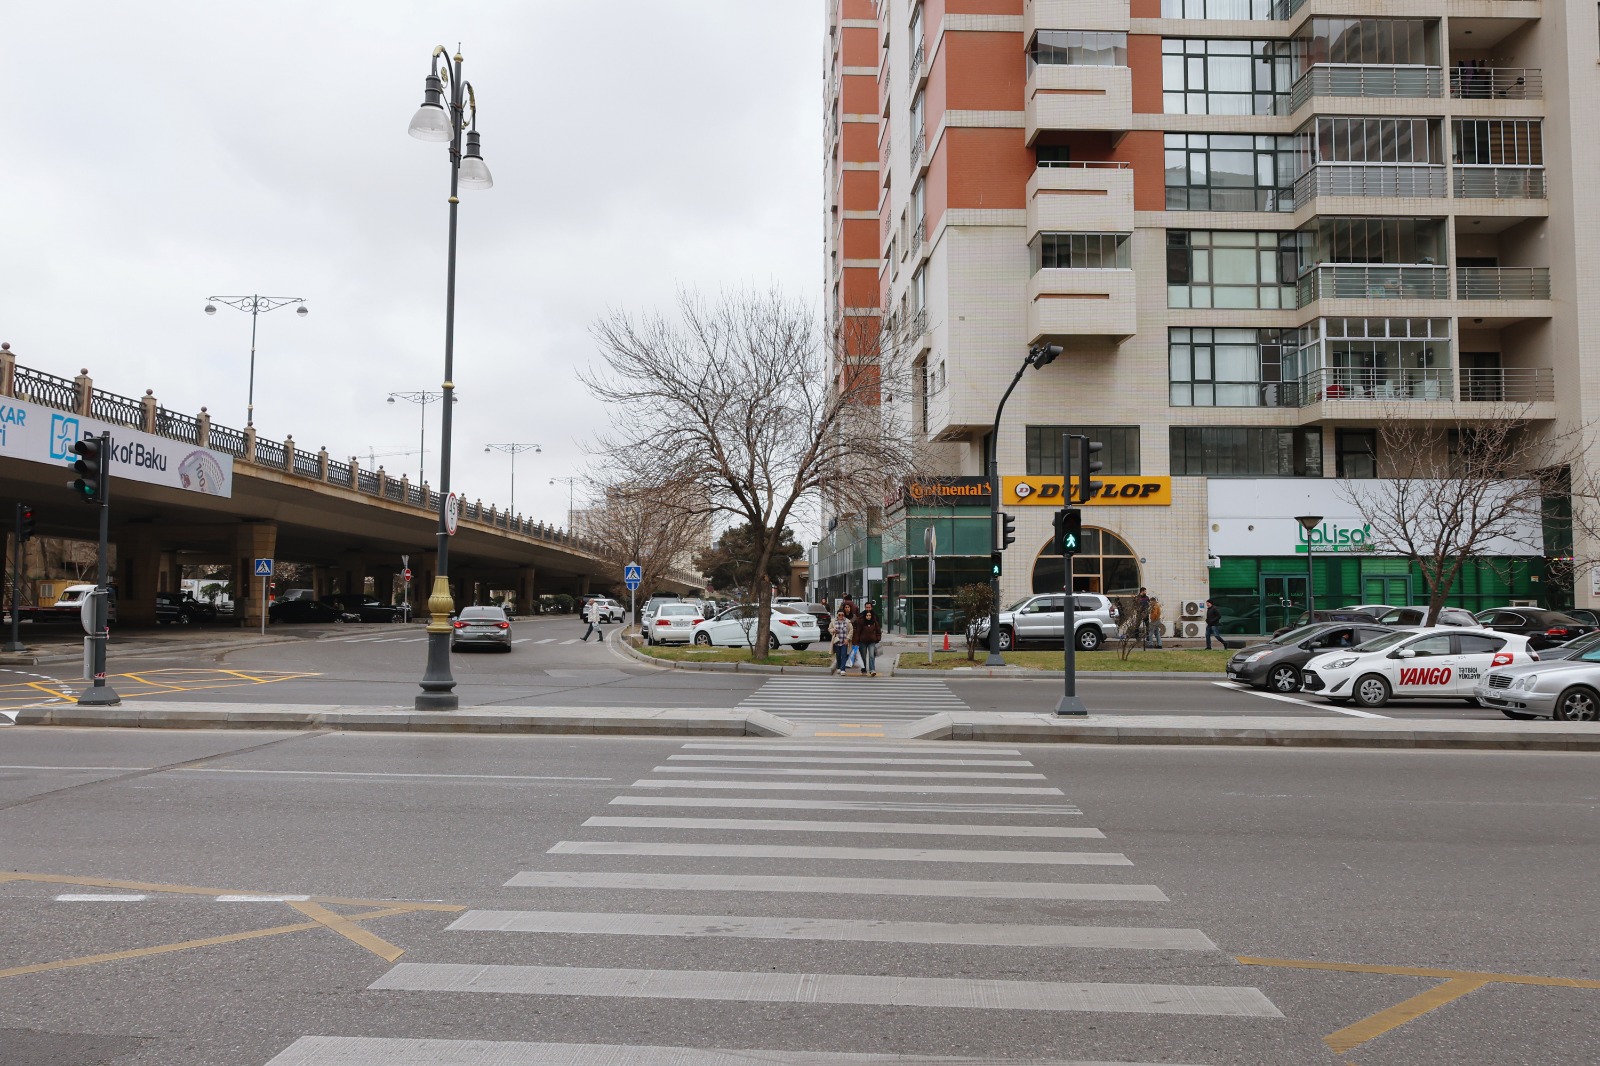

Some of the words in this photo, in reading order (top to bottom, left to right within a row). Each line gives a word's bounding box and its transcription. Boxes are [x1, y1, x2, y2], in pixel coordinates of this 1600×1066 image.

[120, 442, 134, 465] of
[135, 443, 167, 472] Baku
[911, 483, 982, 500] Continental
[1037, 483, 1162, 498] DULOP
[1298, 521, 1365, 544] LaLisa
[1399, 667, 1452, 686] YANGO
